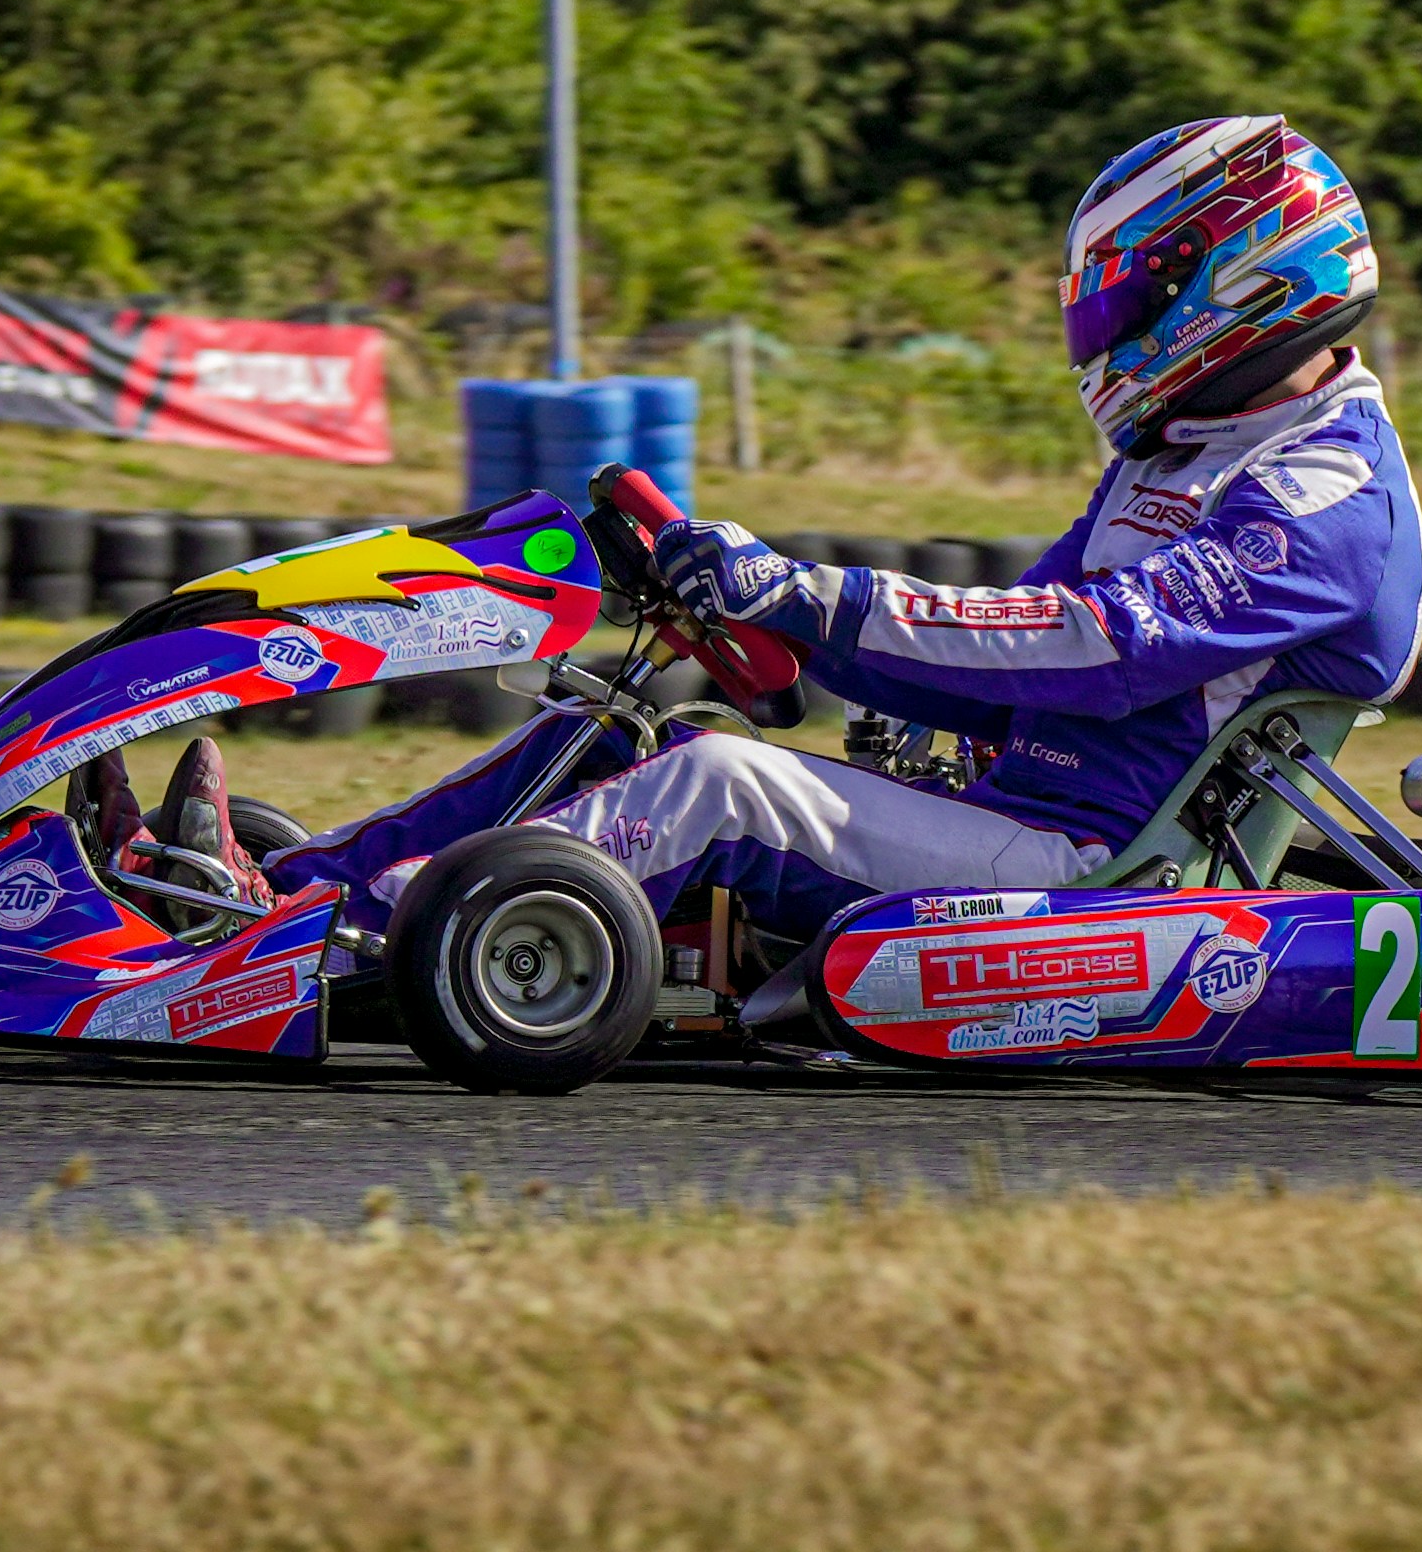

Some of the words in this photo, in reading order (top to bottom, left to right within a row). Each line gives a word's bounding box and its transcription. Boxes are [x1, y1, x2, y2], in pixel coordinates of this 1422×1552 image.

[1167, 319, 1219, 356] Halliday
[1176, 310, 1211, 339] Lewis
[1162, 567, 1194, 608] CORSE
[437, 619, 469, 642] 1st4
[390, 640, 472, 661] thirst.com
[141, 665, 209, 696] VENATOR
[1029, 742, 1080, 770] Crook
[1355, 901, 1419, 1056] 2
[1015, 1004, 1056, 1028] 1st4
[951, 1027, 1056, 1050] thirst.com
